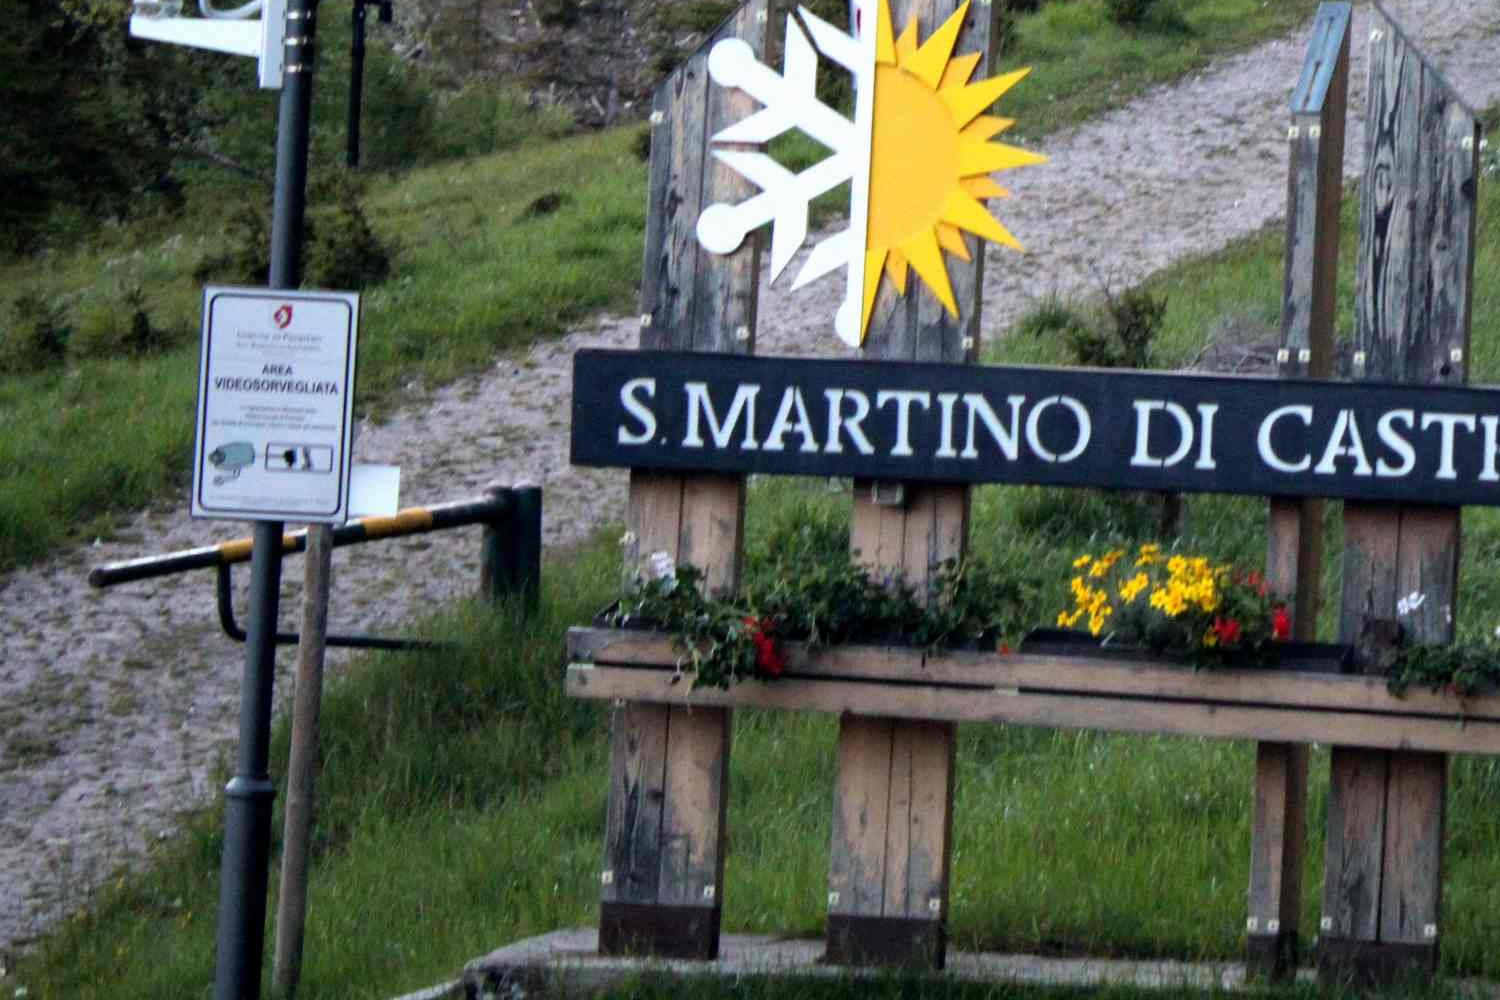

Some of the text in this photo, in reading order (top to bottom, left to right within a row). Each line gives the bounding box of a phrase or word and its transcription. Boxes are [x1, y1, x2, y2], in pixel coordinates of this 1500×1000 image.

[262, 363, 294, 376] AREA
[215, 377, 339, 395] VIDEOSORVEGLIATA
[682, 381, 1092, 463] MARTINO
[1130, 399, 1219, 470] DI
